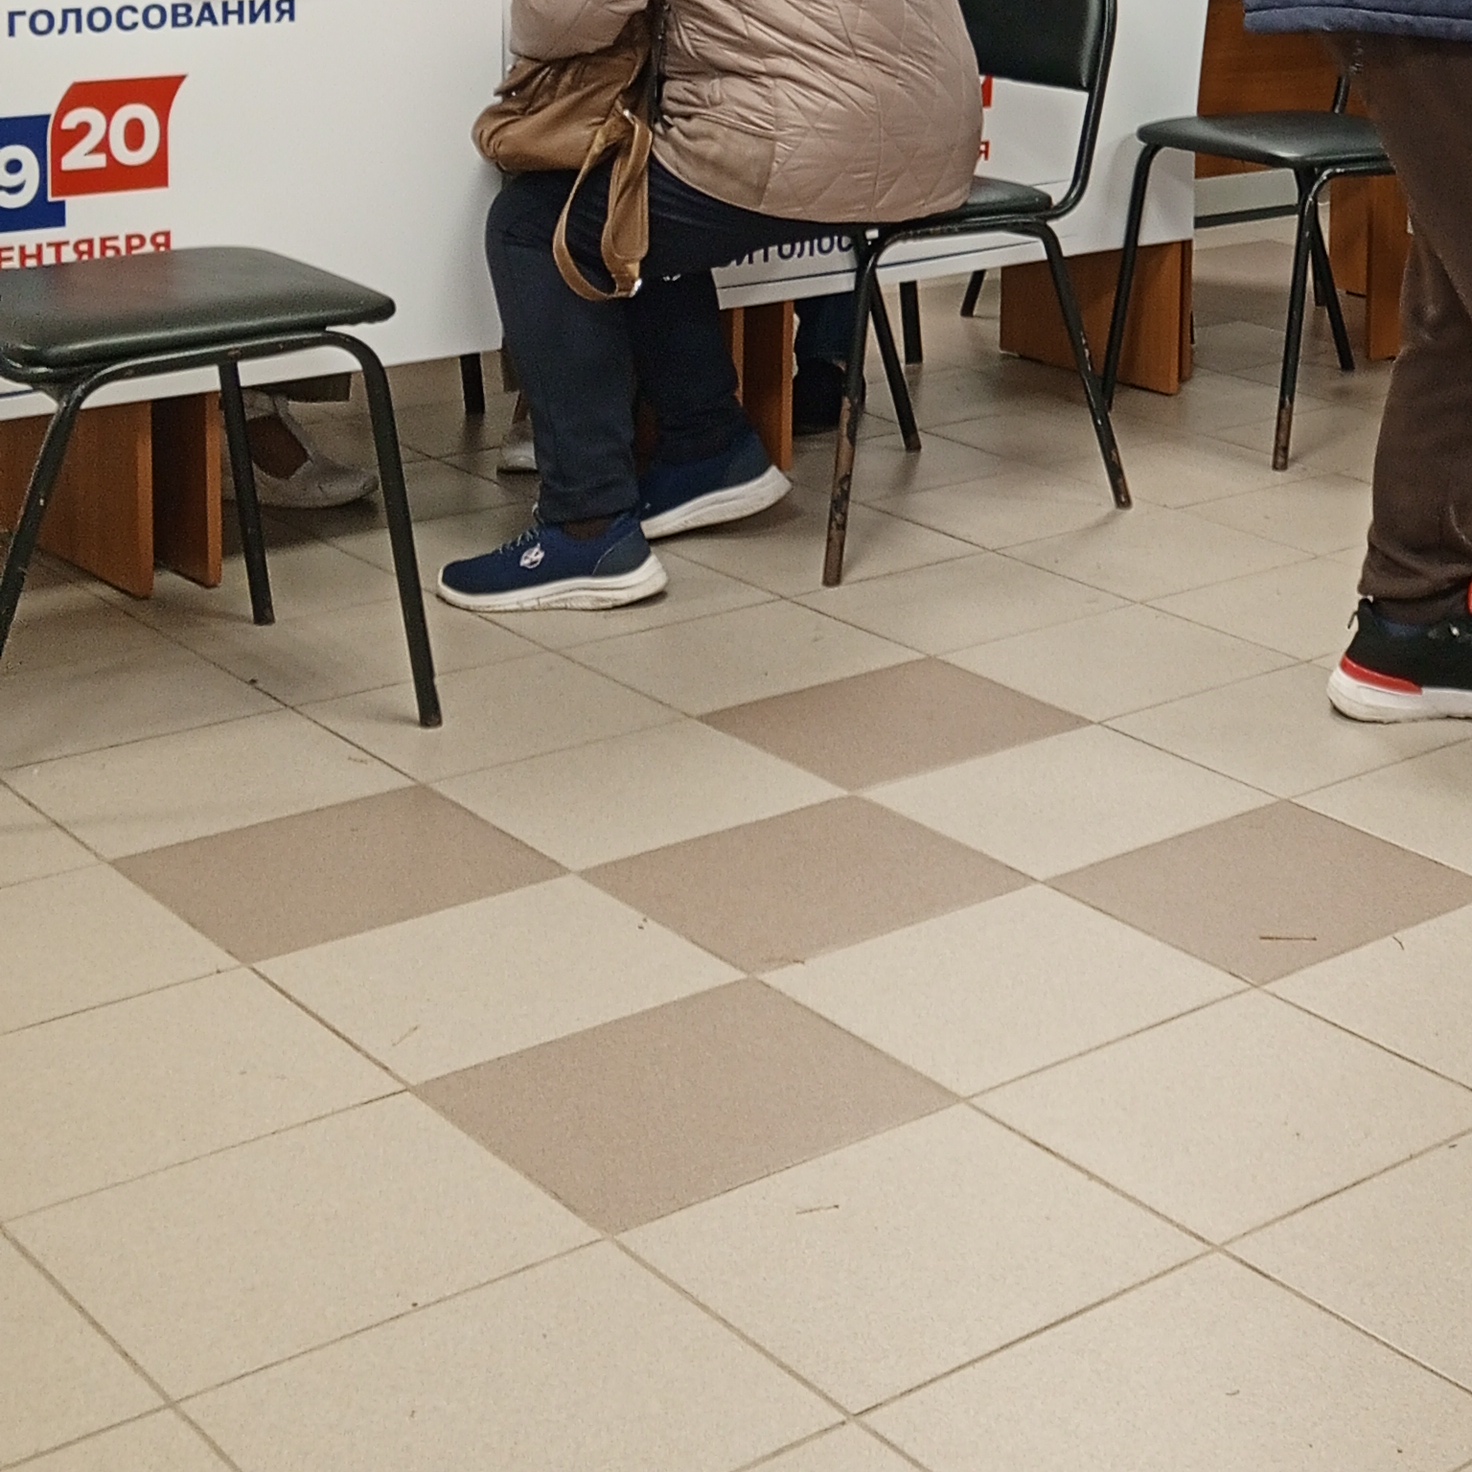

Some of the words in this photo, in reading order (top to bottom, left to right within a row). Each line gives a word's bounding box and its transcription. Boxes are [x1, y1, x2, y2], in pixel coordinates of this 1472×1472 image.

[0, 144, 40, 209] 9
[60, 103, 161, 171] 20
[0, 230, 171, 271] ЕНТЯБРЯ
